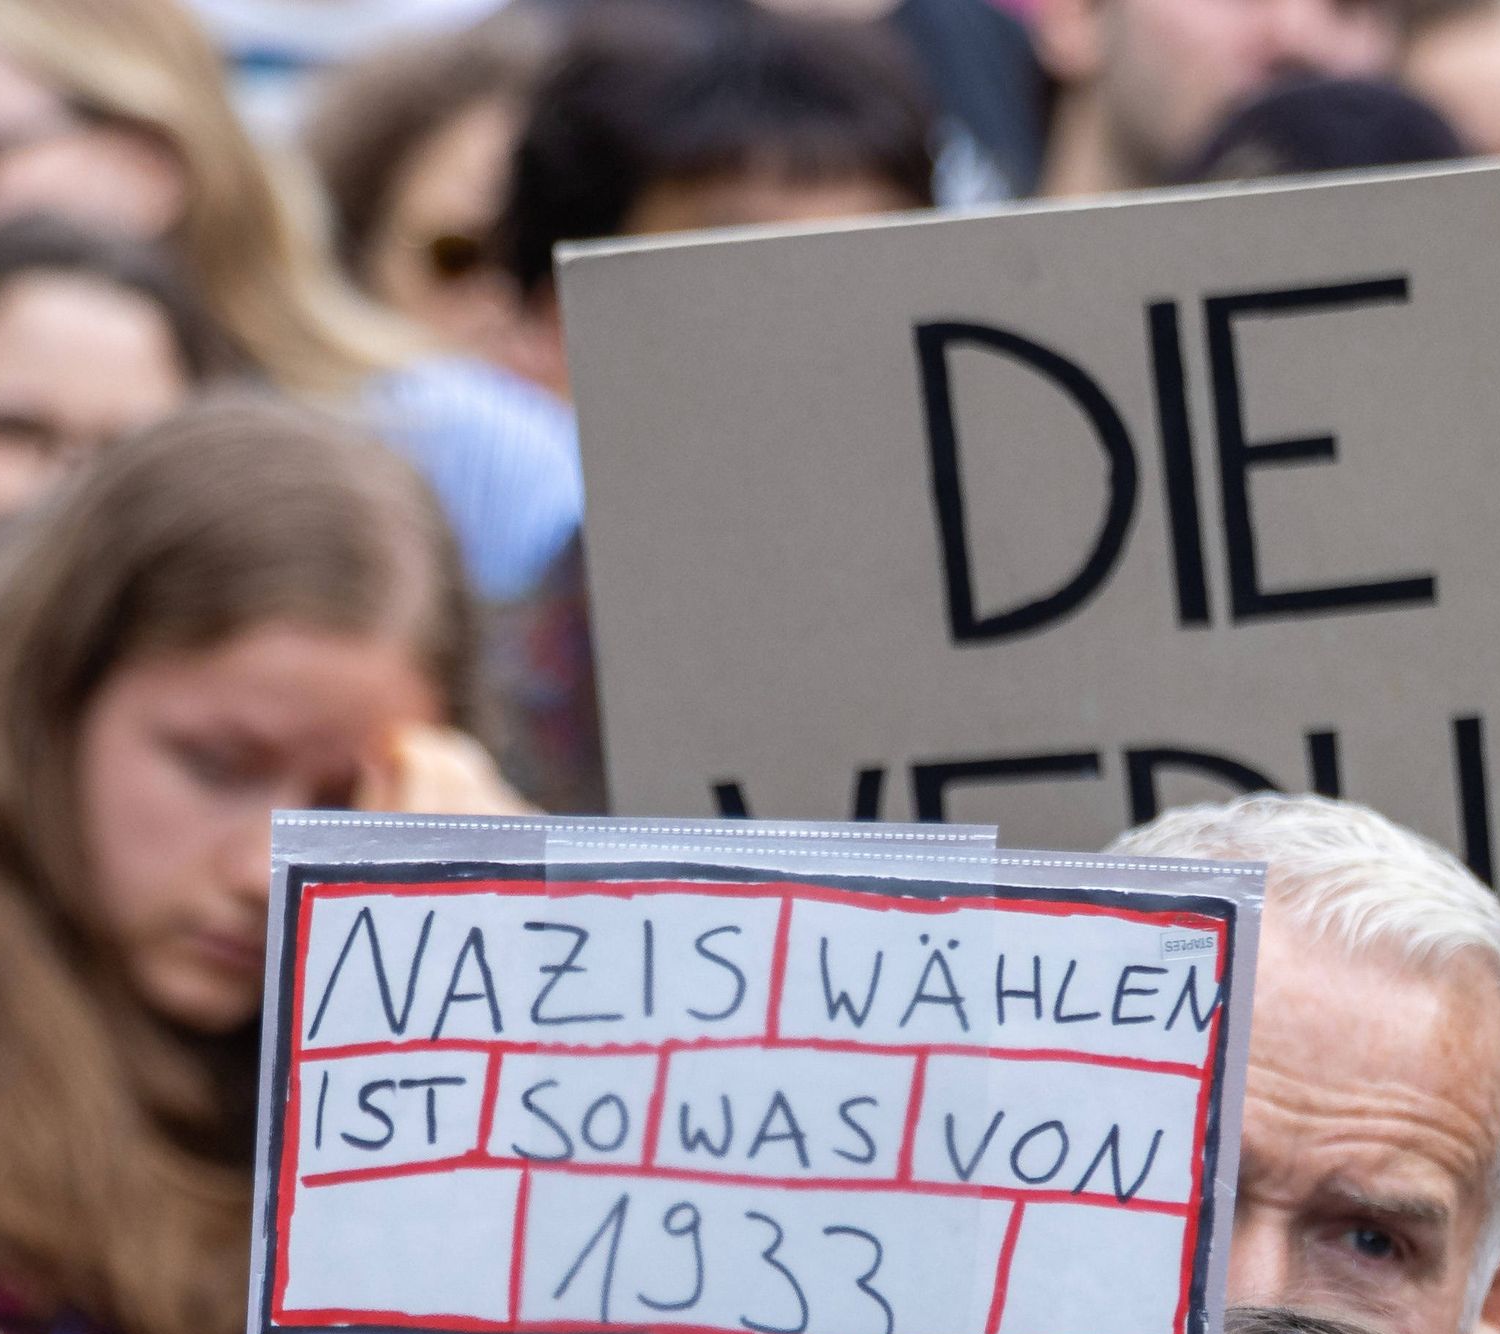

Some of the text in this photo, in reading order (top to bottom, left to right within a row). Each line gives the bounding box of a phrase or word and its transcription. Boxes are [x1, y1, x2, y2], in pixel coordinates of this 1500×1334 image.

[912, 273, 1438, 645] DIE
[308, 906, 1223, 1040] NAZIS WÄHLEN
[314, 1076, 1166, 1199] IST SO WAS VON
